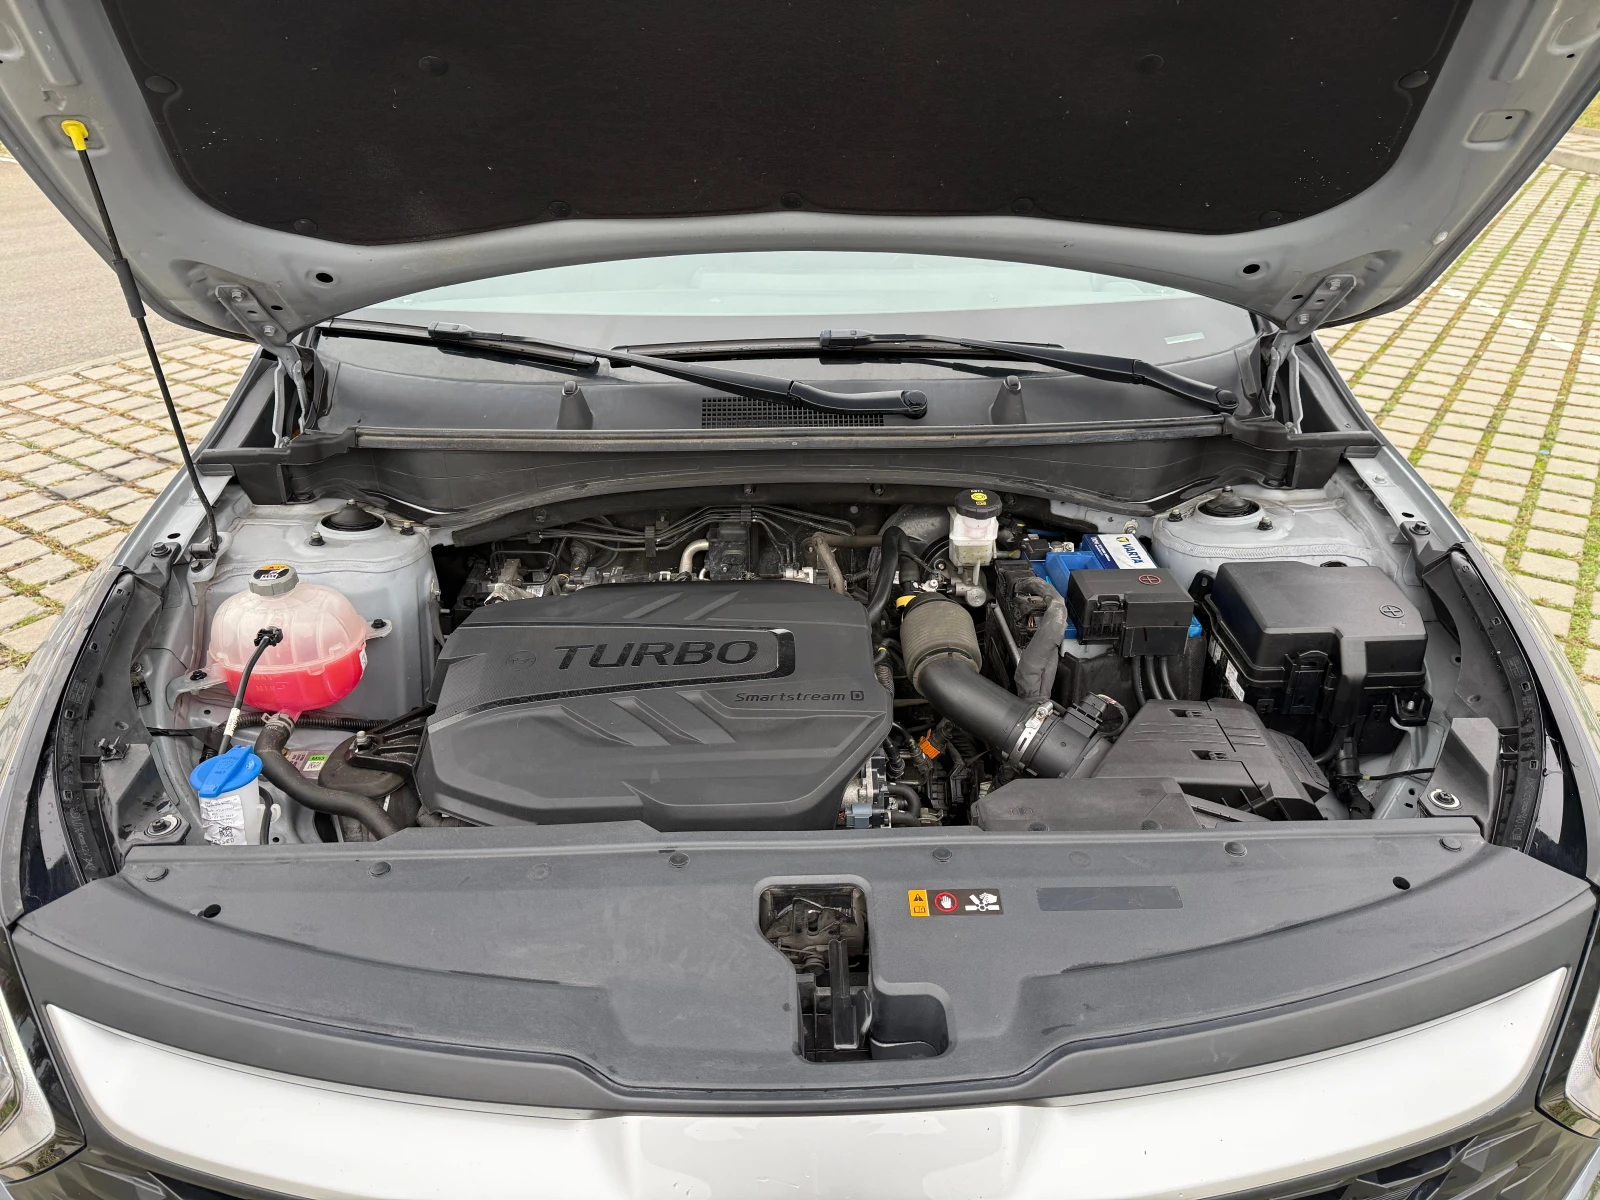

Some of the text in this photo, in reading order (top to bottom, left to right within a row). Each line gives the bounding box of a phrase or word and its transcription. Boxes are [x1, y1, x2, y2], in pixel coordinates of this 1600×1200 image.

[1121, 543, 1144, 564] VARTA
[554, 640, 758, 670] TURBO
[734, 692, 846, 702] Smartstream
